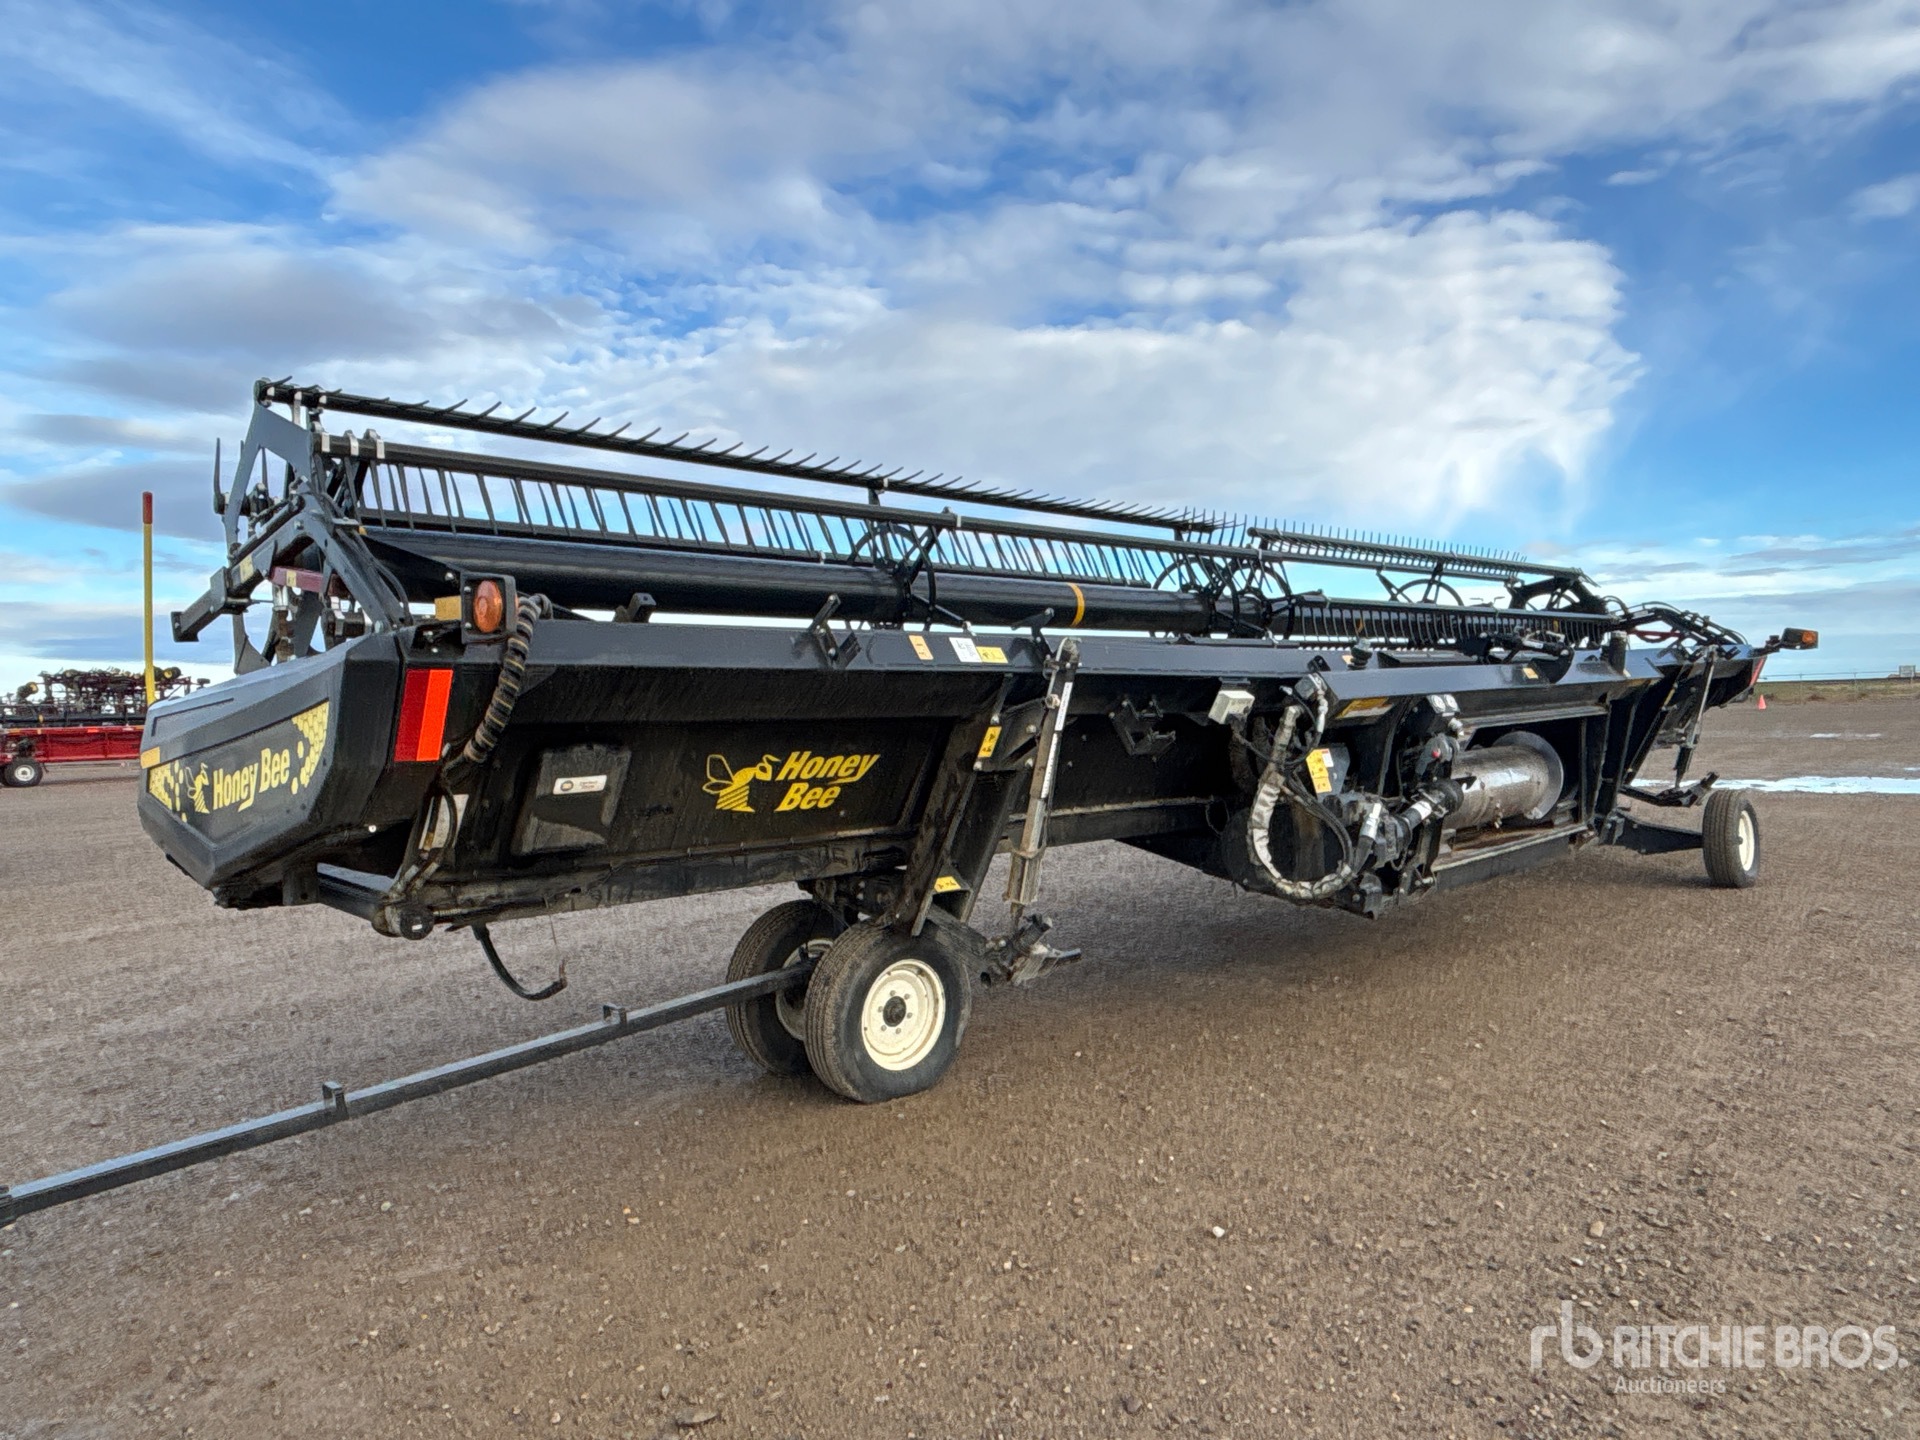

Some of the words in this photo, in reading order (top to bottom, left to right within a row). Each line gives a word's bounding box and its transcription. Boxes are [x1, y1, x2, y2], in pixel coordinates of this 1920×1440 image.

[213, 763, 259, 813] Honey
[259, 748, 290, 793] Bee
[775, 751, 881, 785] Honey
[774, 782, 841, 813] Bee
